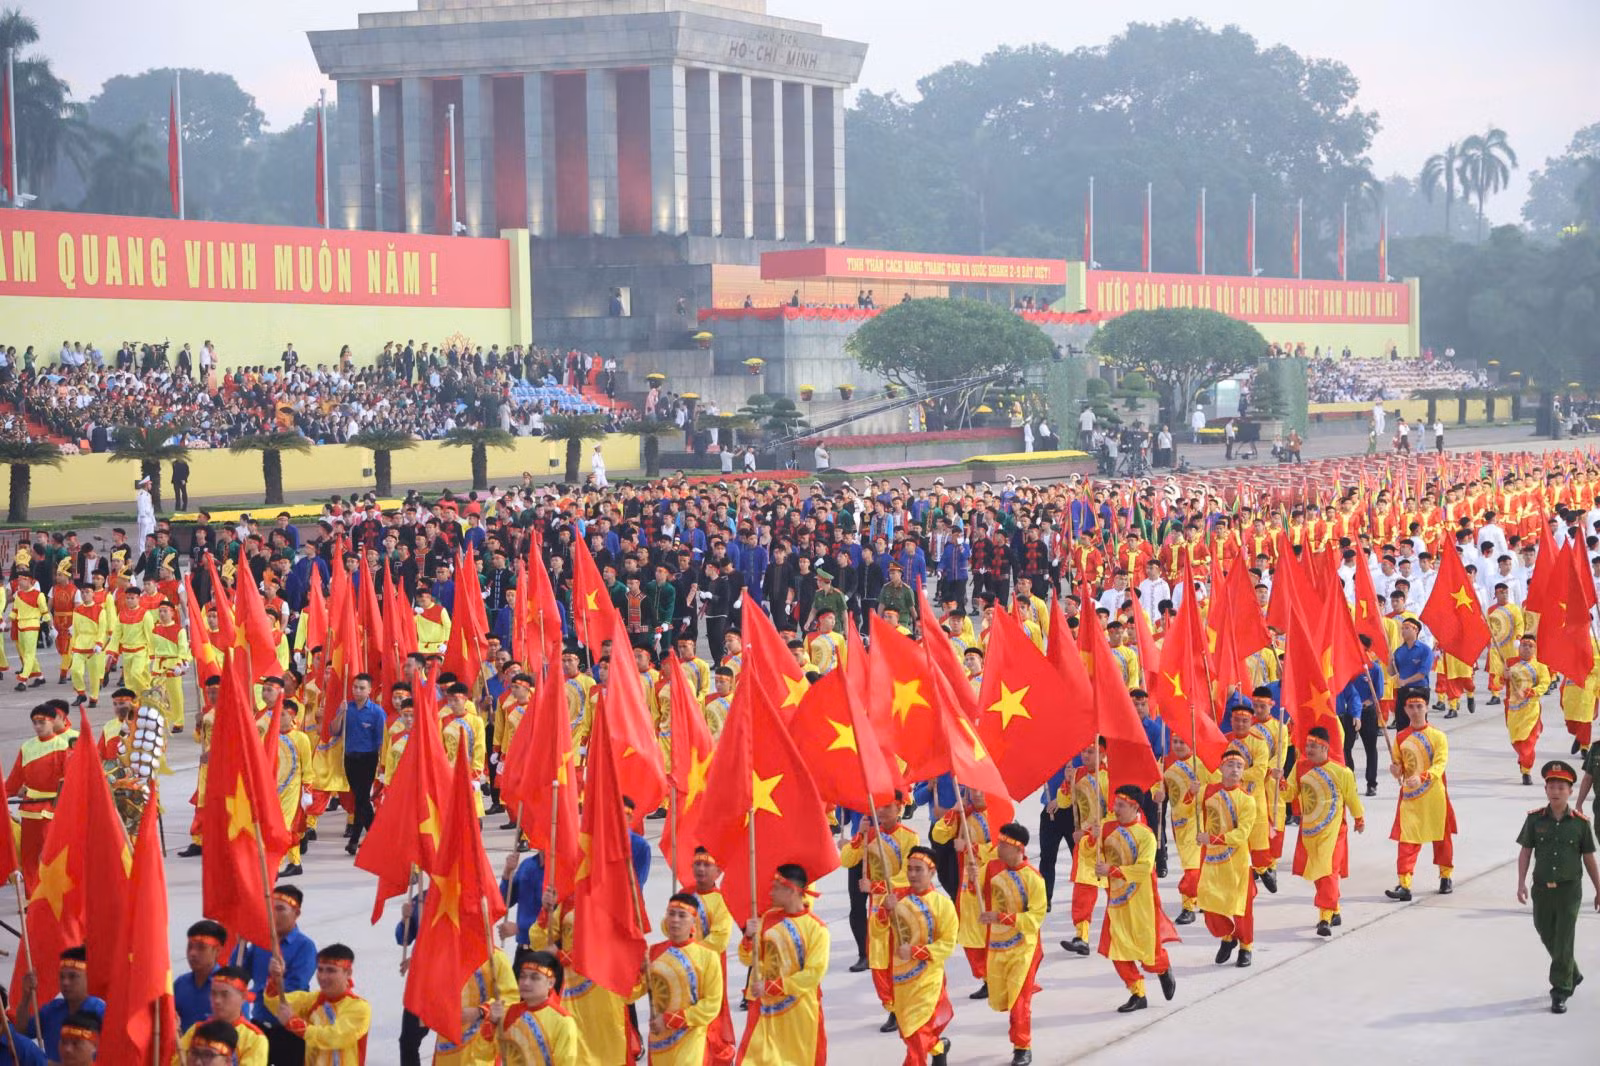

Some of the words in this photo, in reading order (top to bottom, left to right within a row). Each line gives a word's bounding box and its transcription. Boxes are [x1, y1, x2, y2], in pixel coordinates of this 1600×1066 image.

[58, 232, 167, 289] QUANG
[184, 240, 256, 290] VINH
[274, 239, 352, 293] MUÔN
[1098, 276, 1129, 312] NƯỚC
[1239, 281, 1259, 315] CHỦ
[1299, 285, 1320, 320] VIỆT
[1323, 288, 1343, 316] NAM
[1346, 287, 1371, 317] MUÔN
